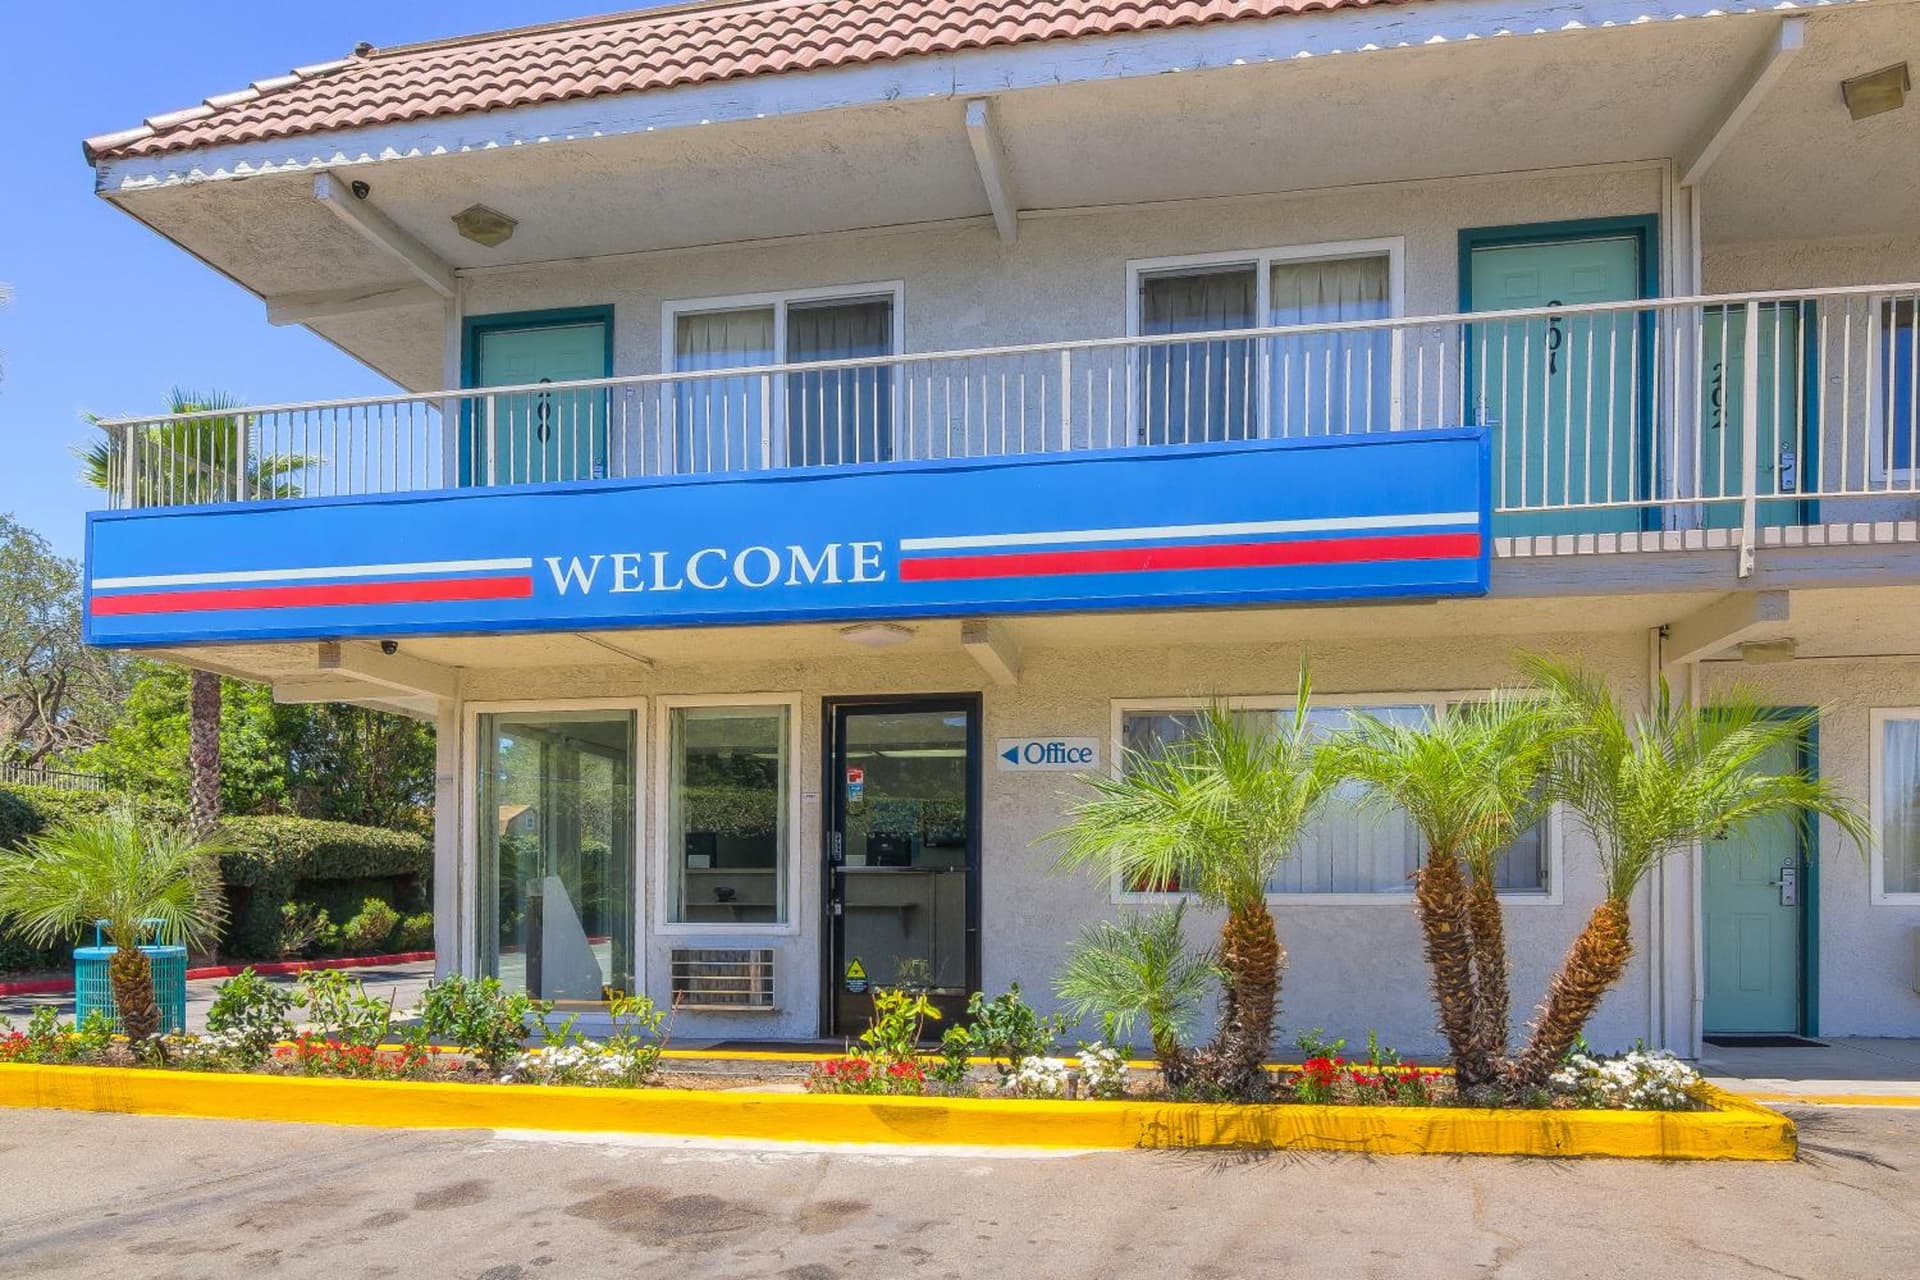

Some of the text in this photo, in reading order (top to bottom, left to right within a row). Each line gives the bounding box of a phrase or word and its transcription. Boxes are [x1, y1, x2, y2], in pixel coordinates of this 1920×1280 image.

[1712, 363, 1728, 429] 202
[544, 541, 886, 596] WELCOME
[1024, 742, 1093, 764] Office
